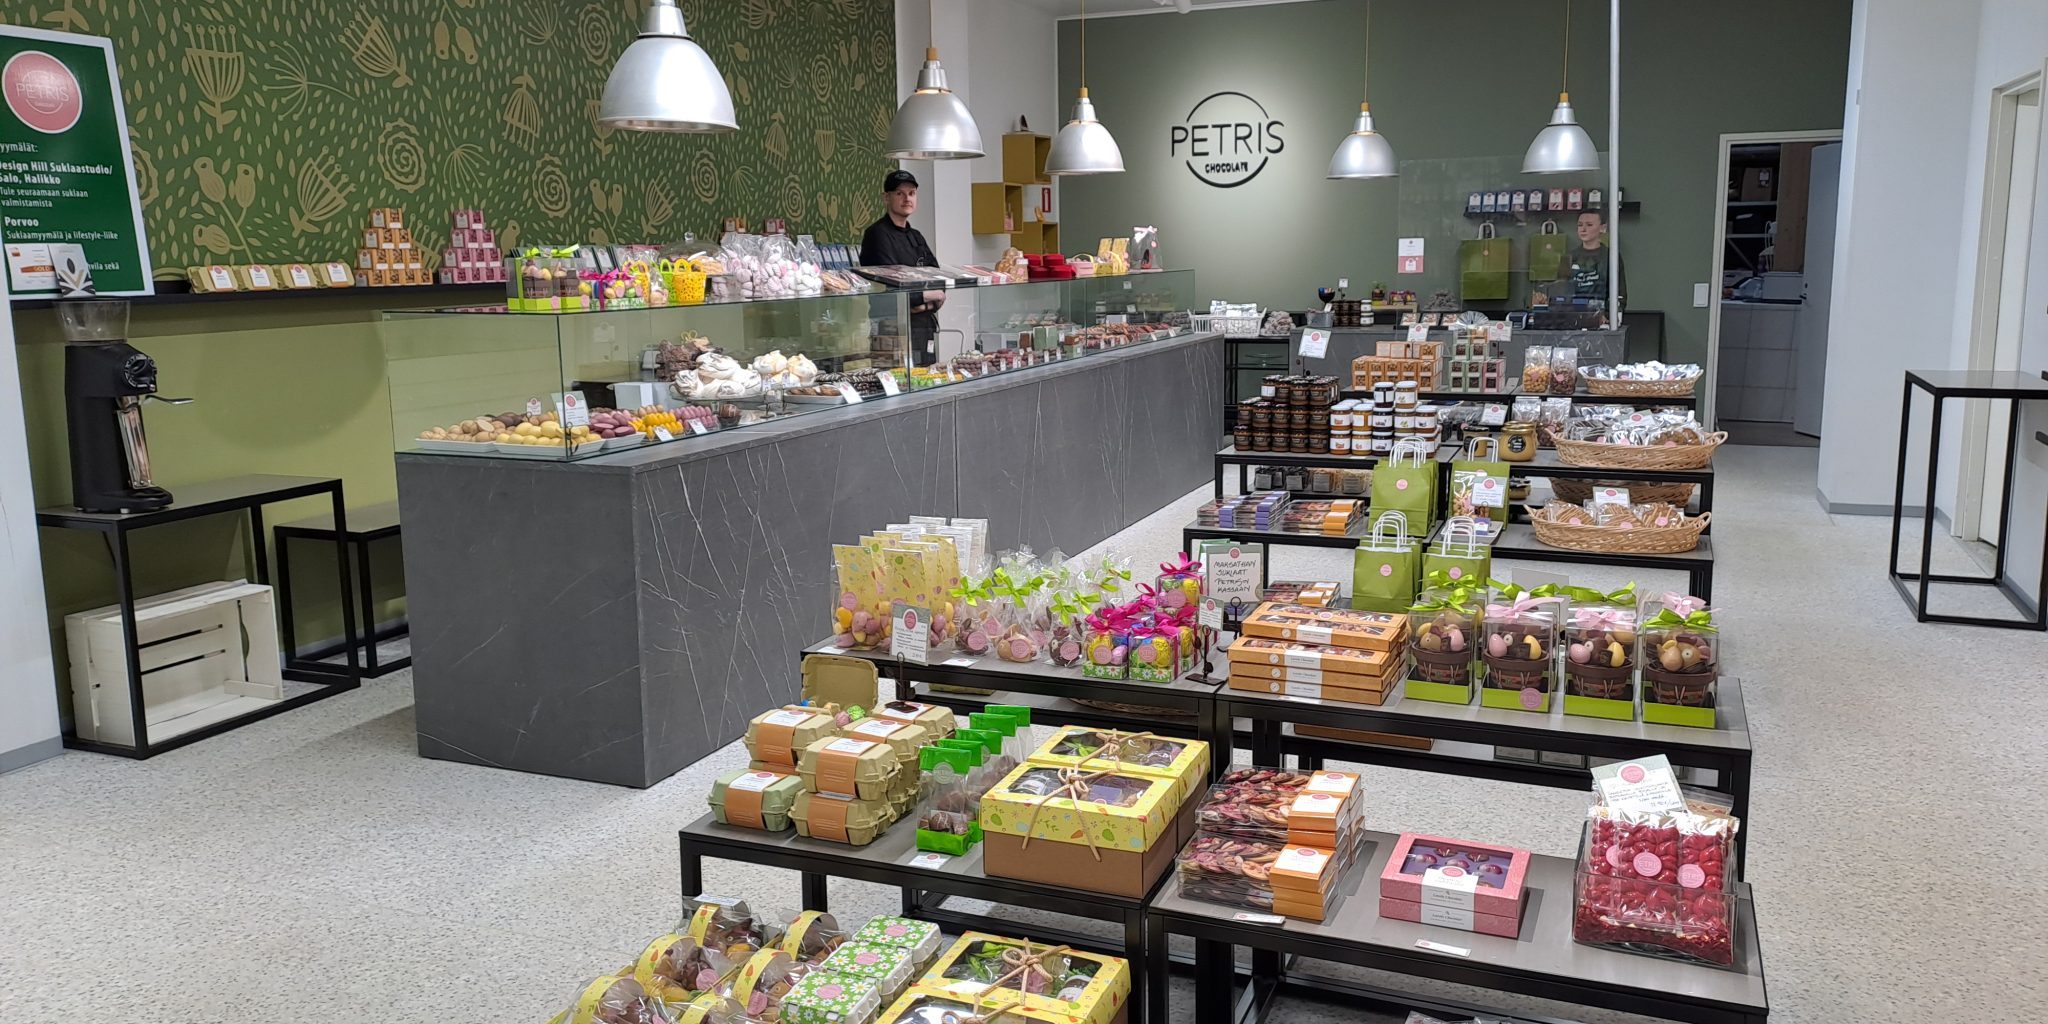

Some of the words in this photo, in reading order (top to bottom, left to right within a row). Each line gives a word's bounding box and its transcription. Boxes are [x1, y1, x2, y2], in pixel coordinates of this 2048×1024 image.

[16, 83, 69, 102] PETRIS
[1171, 120, 1285, 158] PETRIS
[31, 161, 49, 172] Hill
[50, 162, 113, 175] Suklaastudio/
[1205, 162, 1248, 174] CHOCOLATE
[0, 173, 22, 184] Salo,
[24, 173, 61, 184] Halikko
[0, 187, 15, 195] Tule
[17, 188, 60, 196] seuraamaan
[62, 189, 88, 198] suklaan
[2, 199, 53, 208] valmistamista
[4, 216, 39, 227] Porvoo
[7, 231, 64, 240] Suklaamyymälä
[65, 232, 72, 240] ja
[73, 231, 118, 241] lifestyle-liike
[104, 262, 120, 270] sekä
